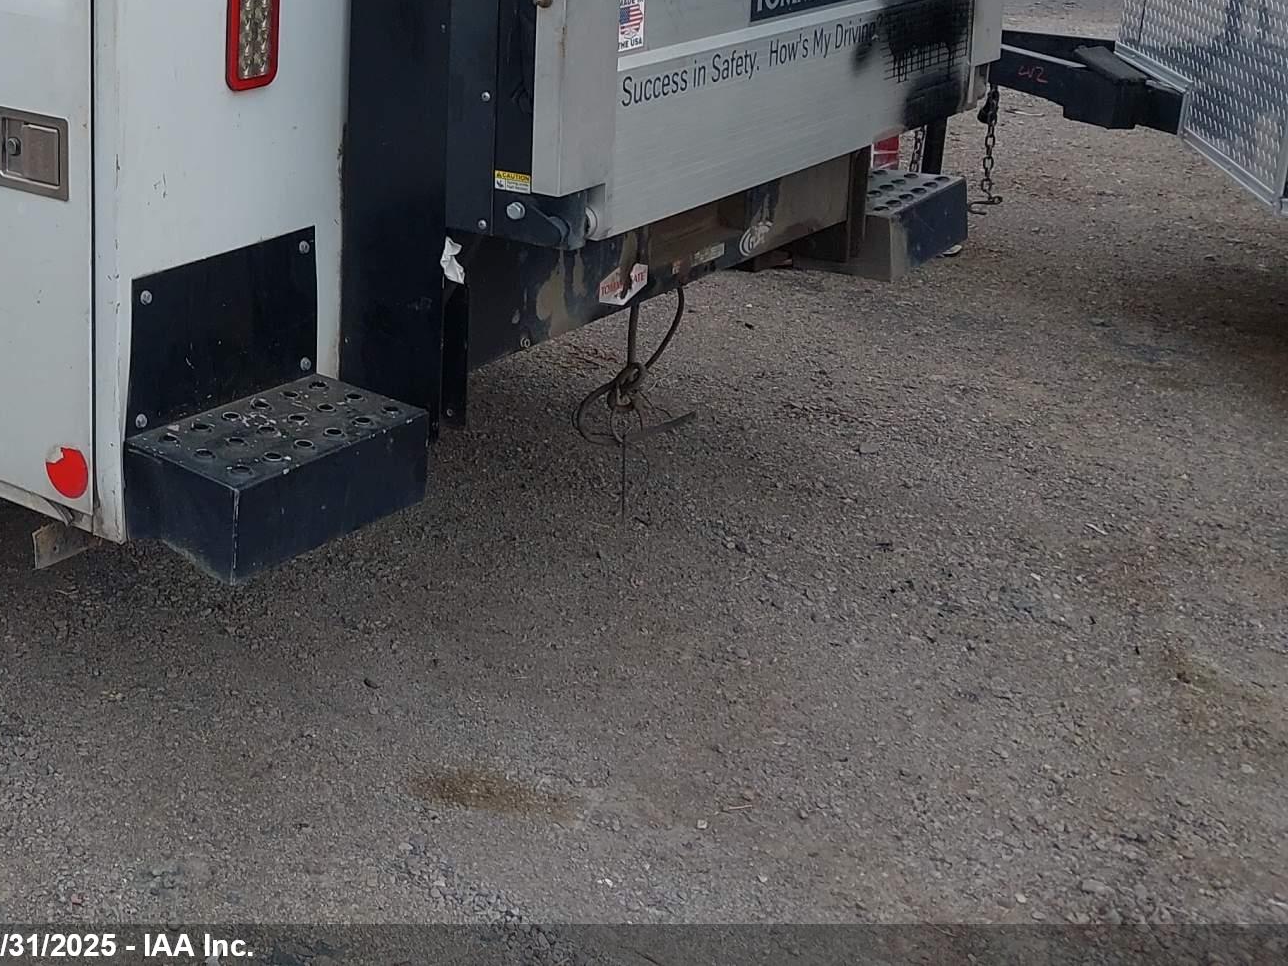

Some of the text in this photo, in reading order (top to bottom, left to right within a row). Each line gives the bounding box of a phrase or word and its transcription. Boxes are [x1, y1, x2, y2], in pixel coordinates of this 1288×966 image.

[631, 36, 643, 47] USA
[621, 68, 688, 107] Success
[693, 60, 706, 88] in
[711, 50, 760, 84] Safety.
[768, 33, 809, 68] How's
[813, 29, 831, 58] My
